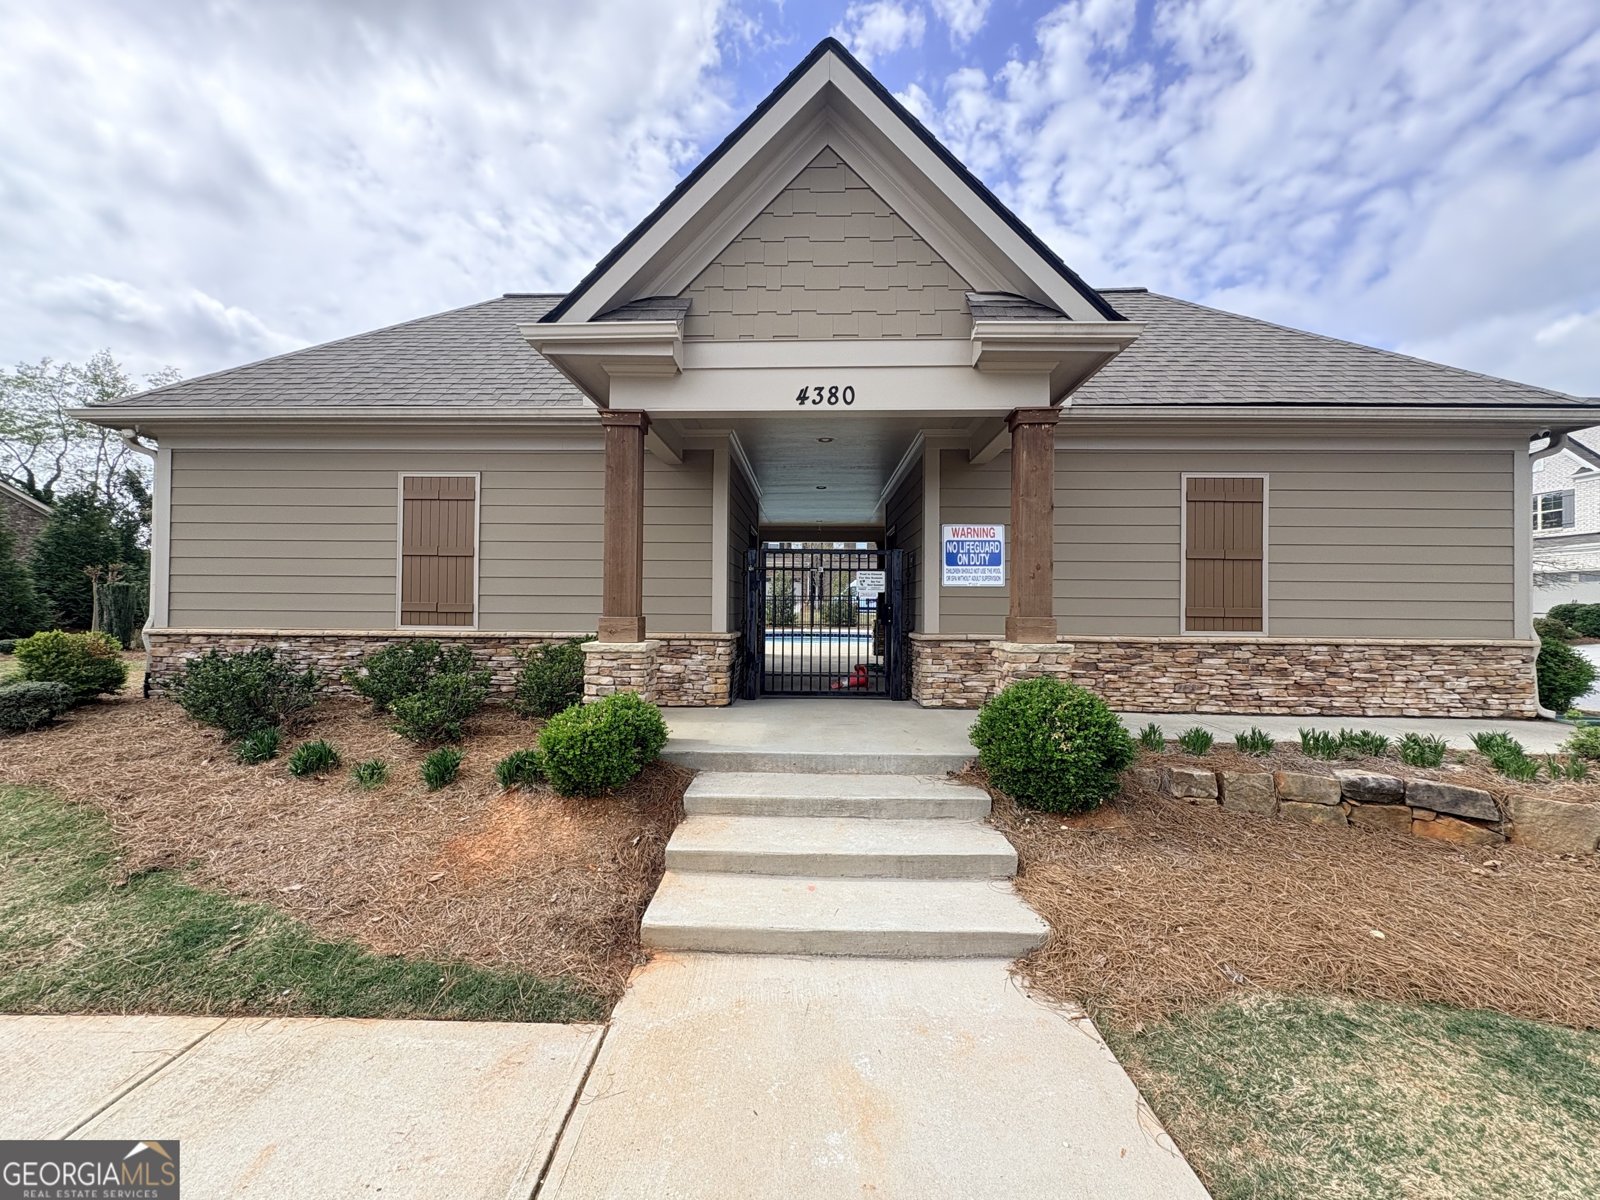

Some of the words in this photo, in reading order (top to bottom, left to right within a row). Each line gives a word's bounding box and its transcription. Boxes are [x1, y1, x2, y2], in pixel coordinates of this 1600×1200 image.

[796, 386, 855, 405] 4380
[951, 527, 996, 538] WARNING
[946, 541, 958, 553] NO
[959, 541, 1001, 553] LIFEGUARD
[957, 553, 968, 565] ON
[970, 554, 990, 565] DUTY
